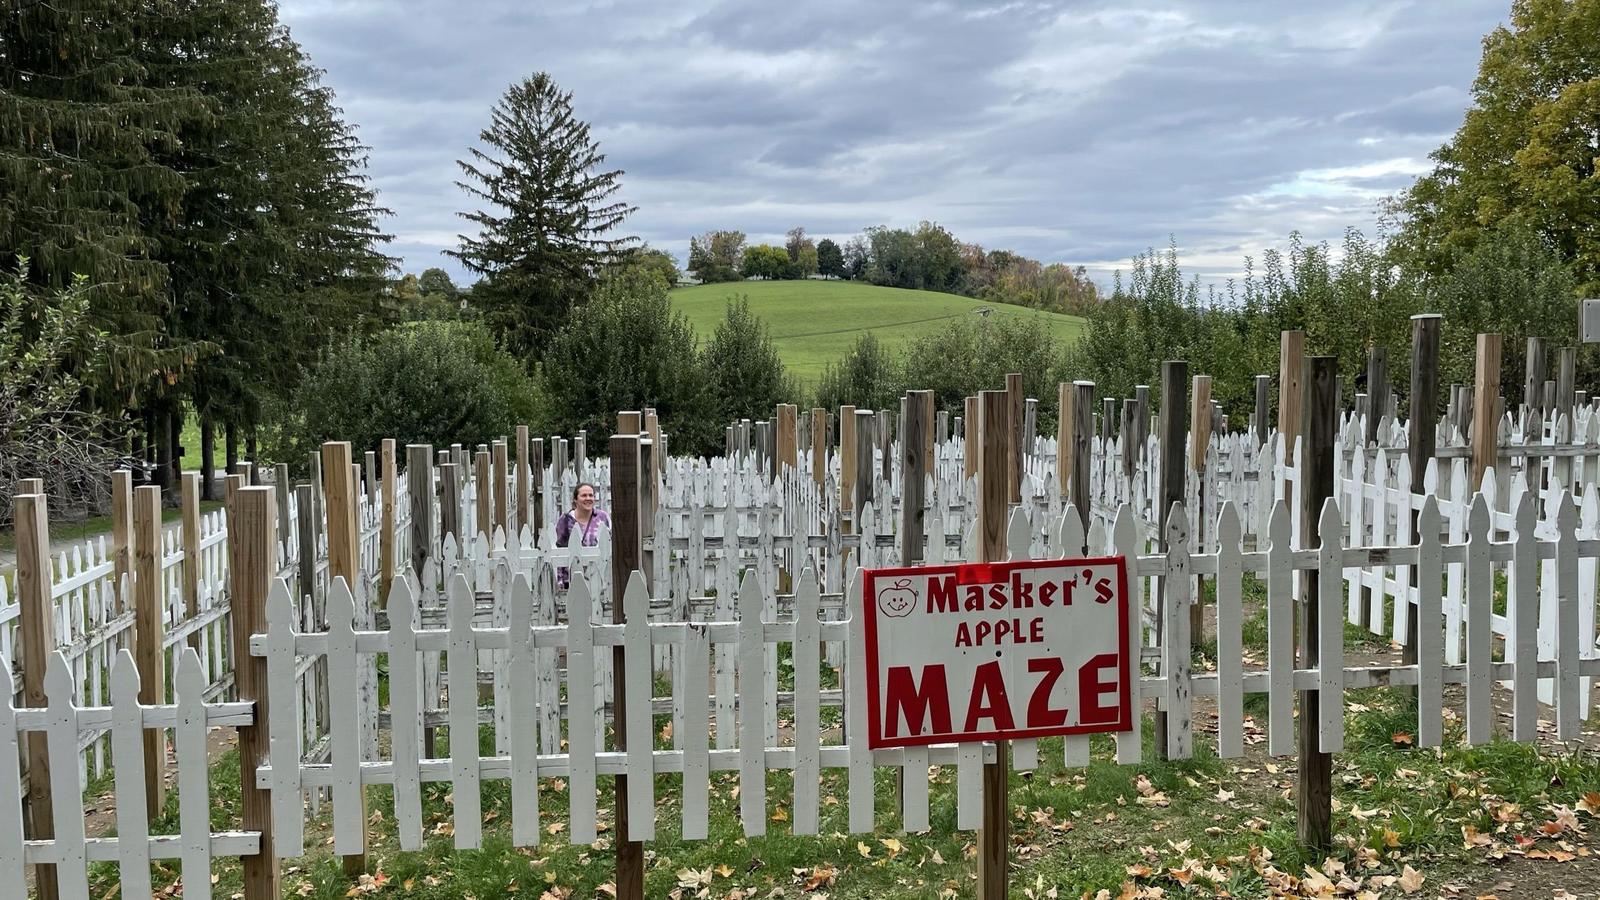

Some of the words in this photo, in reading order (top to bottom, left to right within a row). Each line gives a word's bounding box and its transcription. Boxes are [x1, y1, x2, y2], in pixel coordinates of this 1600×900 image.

[926, 568, 1114, 614] Masker's
[955, 617, 1044, 648] APPLE
[885, 653, 1120, 738] MAZE
